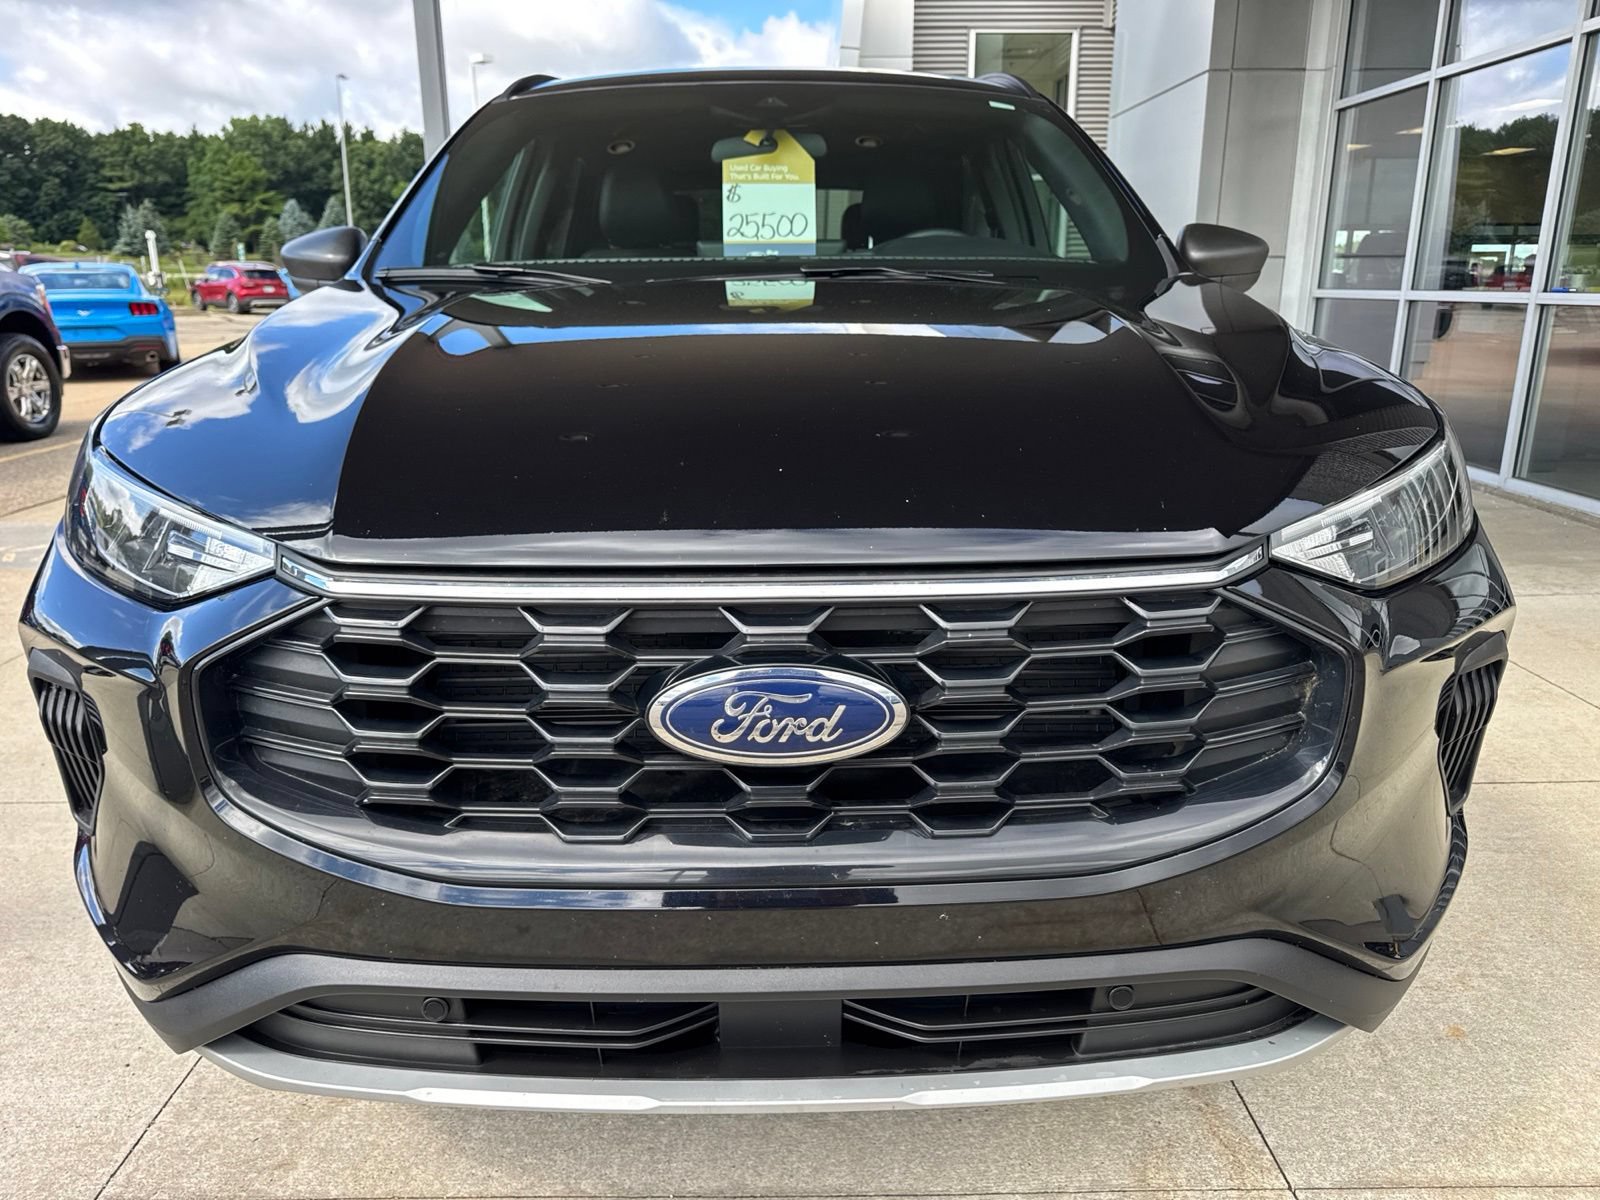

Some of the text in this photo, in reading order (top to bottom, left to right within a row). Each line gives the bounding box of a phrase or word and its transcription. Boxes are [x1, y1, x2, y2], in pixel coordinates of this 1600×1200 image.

[729, 164, 788, 173] Used Car Buying
[729, 173, 752, 181] That's
[753, 173, 770, 181] Built
[771, 173, 783, 181] For
[726, 183, 741, 203] $
[710, 690, 846, 744] Ford
